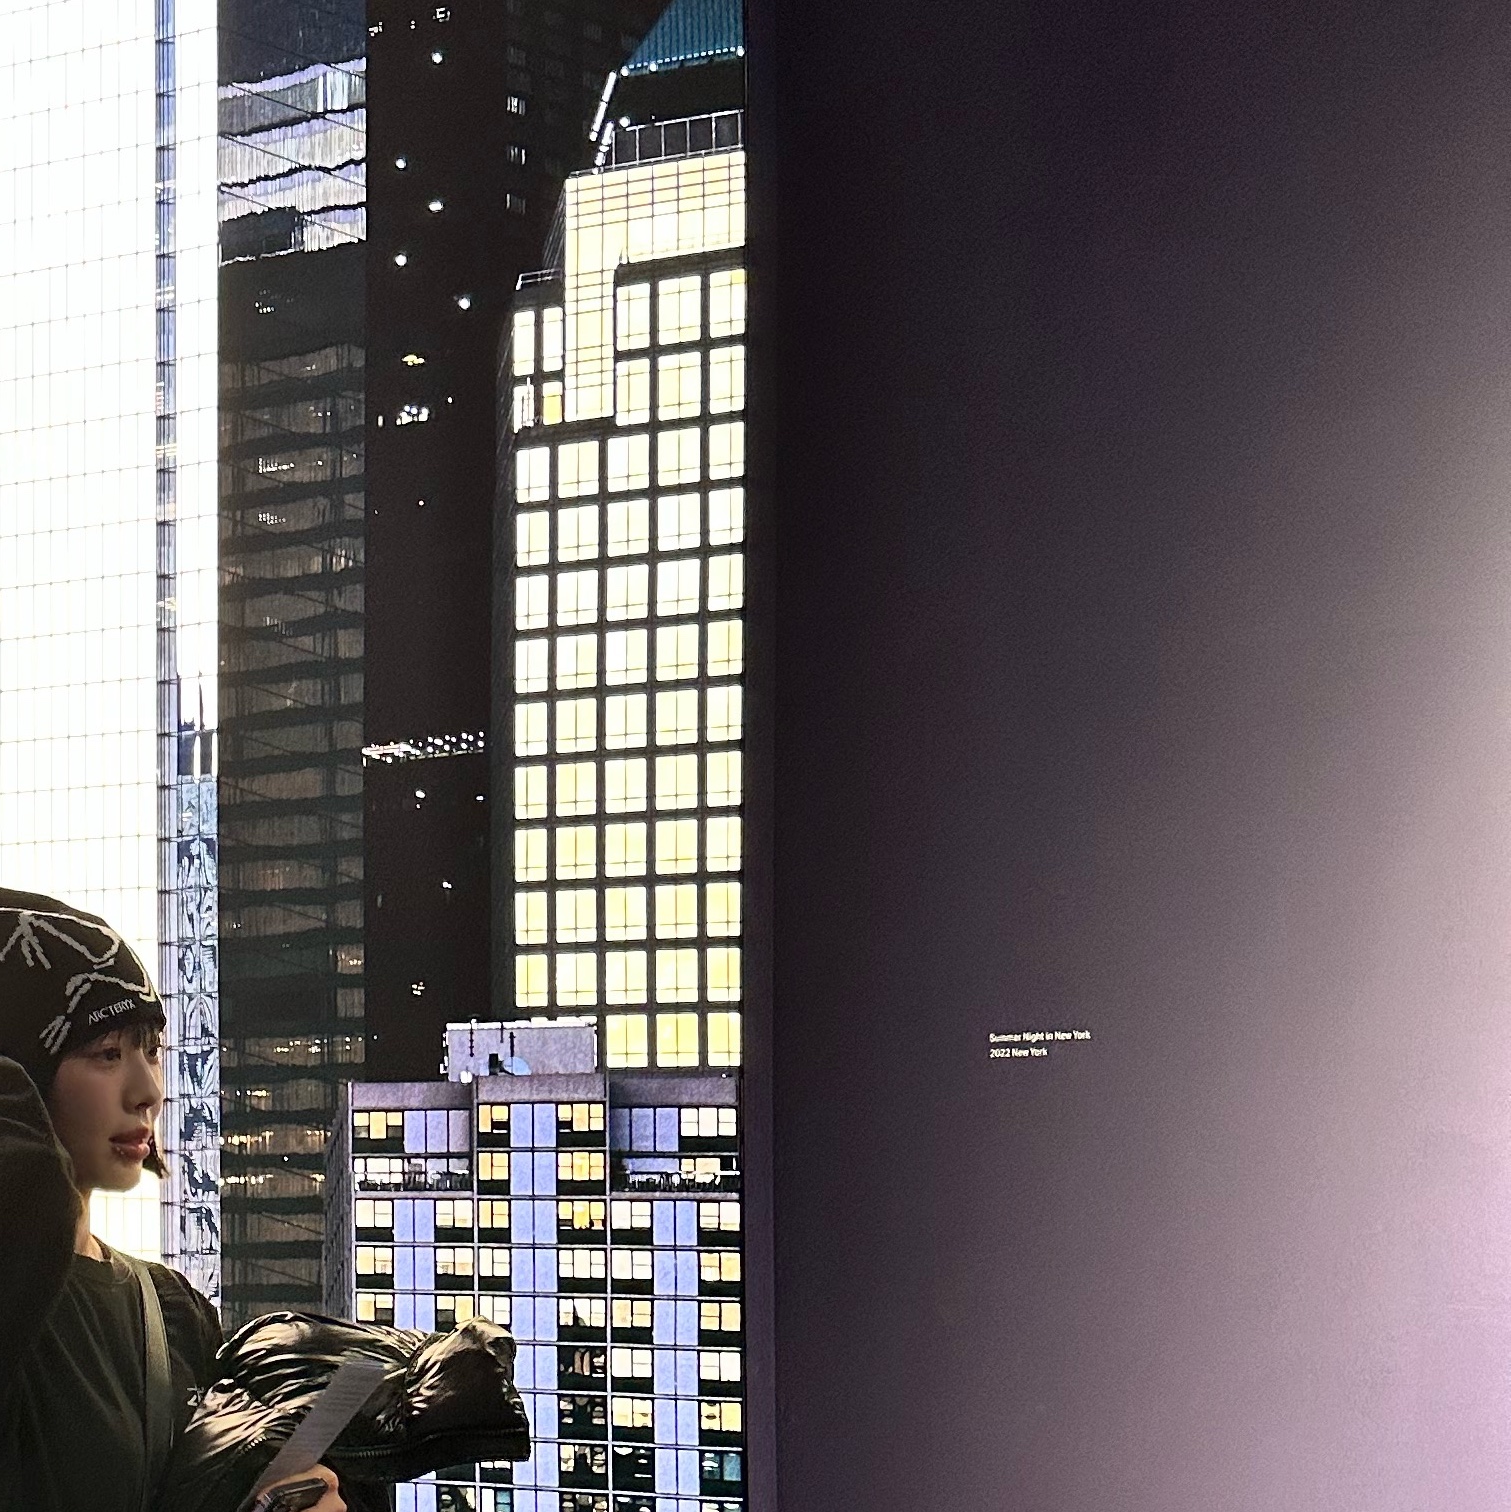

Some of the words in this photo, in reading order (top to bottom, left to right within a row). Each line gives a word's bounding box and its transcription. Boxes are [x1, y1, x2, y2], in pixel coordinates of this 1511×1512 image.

[989, 1032, 1021, 1043] Summer
[1022, 1031, 1044, 1044] Night
[1045, 1031, 1054, 1041] in
[1054, 1030, 1072, 1041] New
[1072, 1029, 1091, 1040] York
[989, 1048, 1011, 1059] 2022
[1011, 1047, 1029, 1058] New
[1029, 1046, 1048, 1057] York
